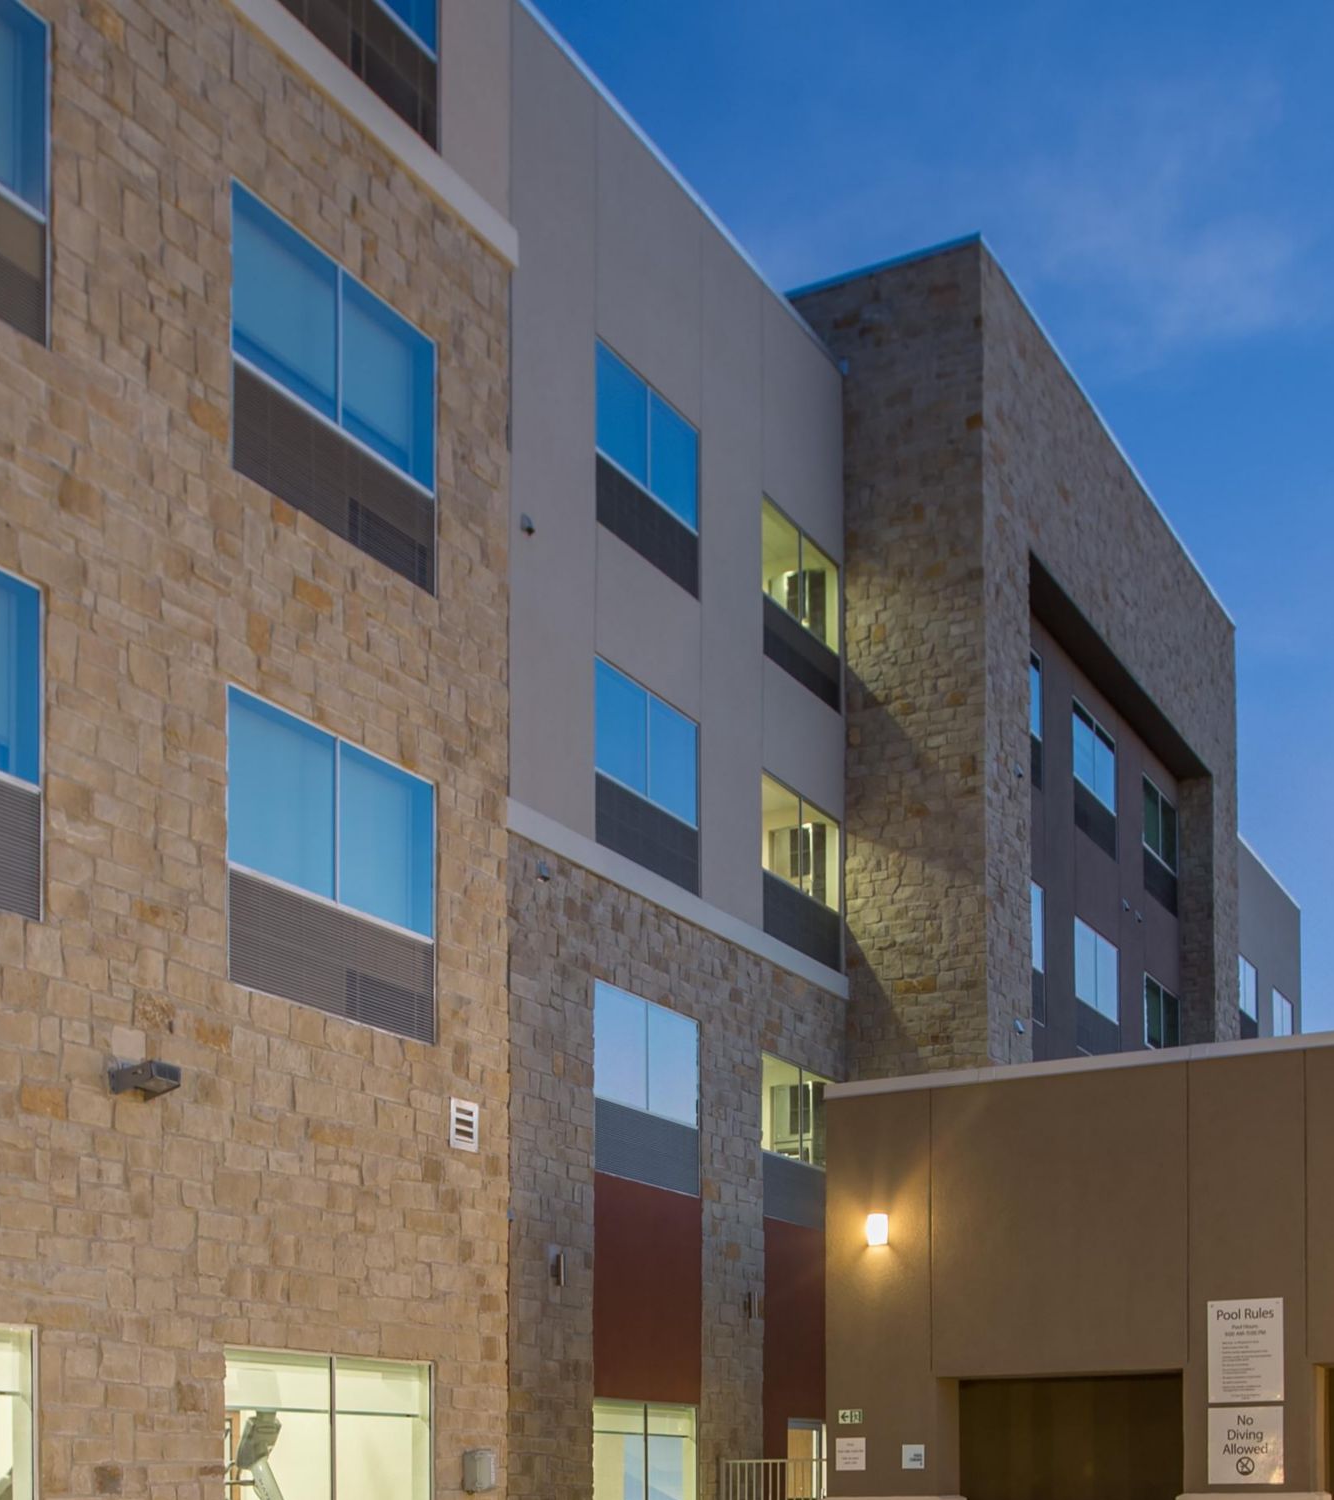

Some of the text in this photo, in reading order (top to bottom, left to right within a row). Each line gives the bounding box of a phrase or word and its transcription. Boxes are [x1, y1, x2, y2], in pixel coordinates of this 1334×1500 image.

[1216, 1307, 1275, 1321] Pool Rules
[1236, 1415, 1254, 1426] No
[1227, 1429, 1264, 1441] Diving
[1222, 1443, 1268, 1455] Allowed
